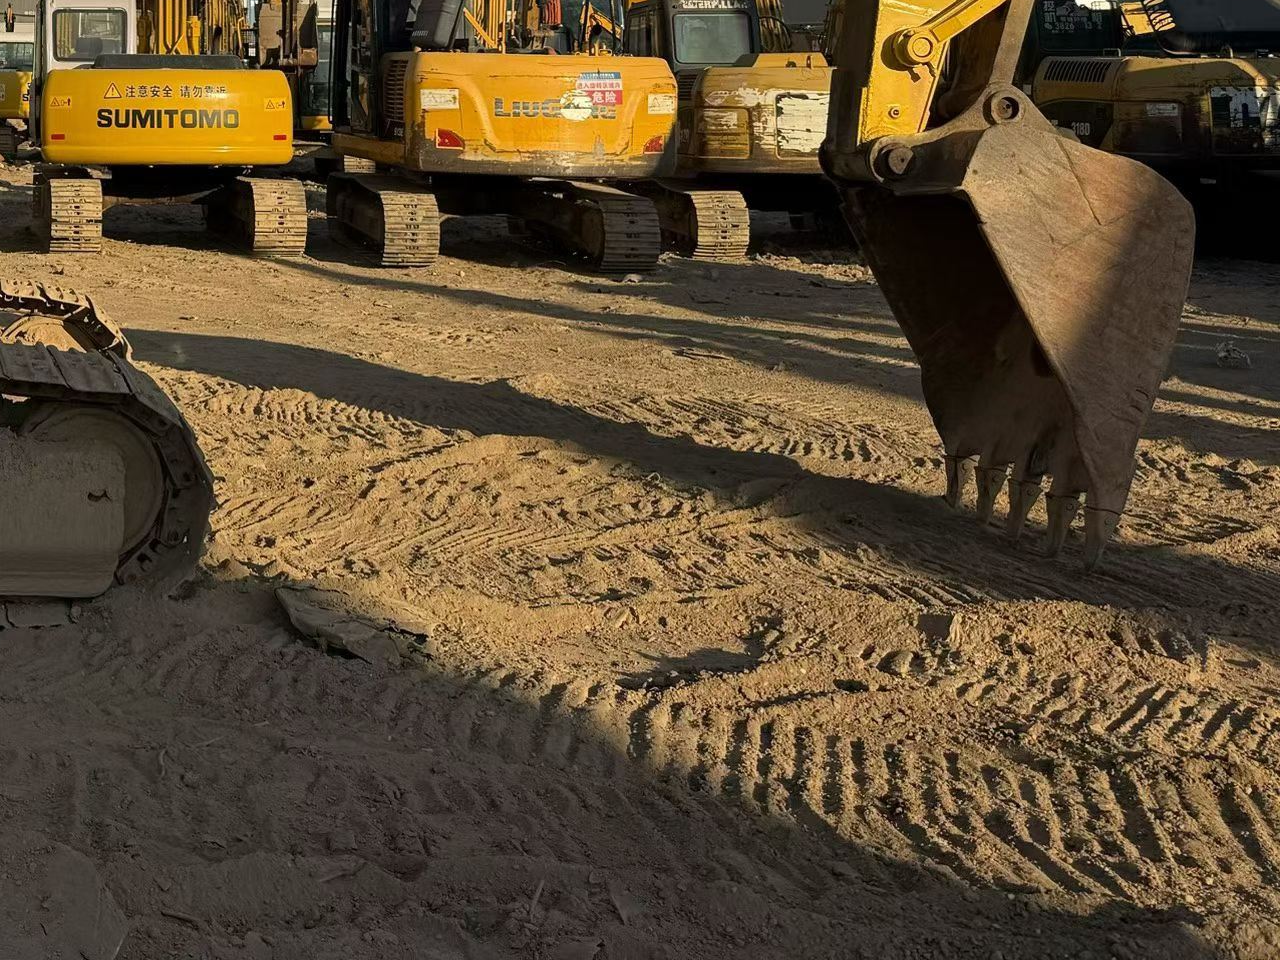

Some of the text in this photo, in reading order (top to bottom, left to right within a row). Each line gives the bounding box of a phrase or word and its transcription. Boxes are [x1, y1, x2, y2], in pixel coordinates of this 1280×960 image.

[125, 85, 173, 98] 注意安全
[592, 91, 617, 103] 危险
[96, 109, 240, 129] SUMITOMO
